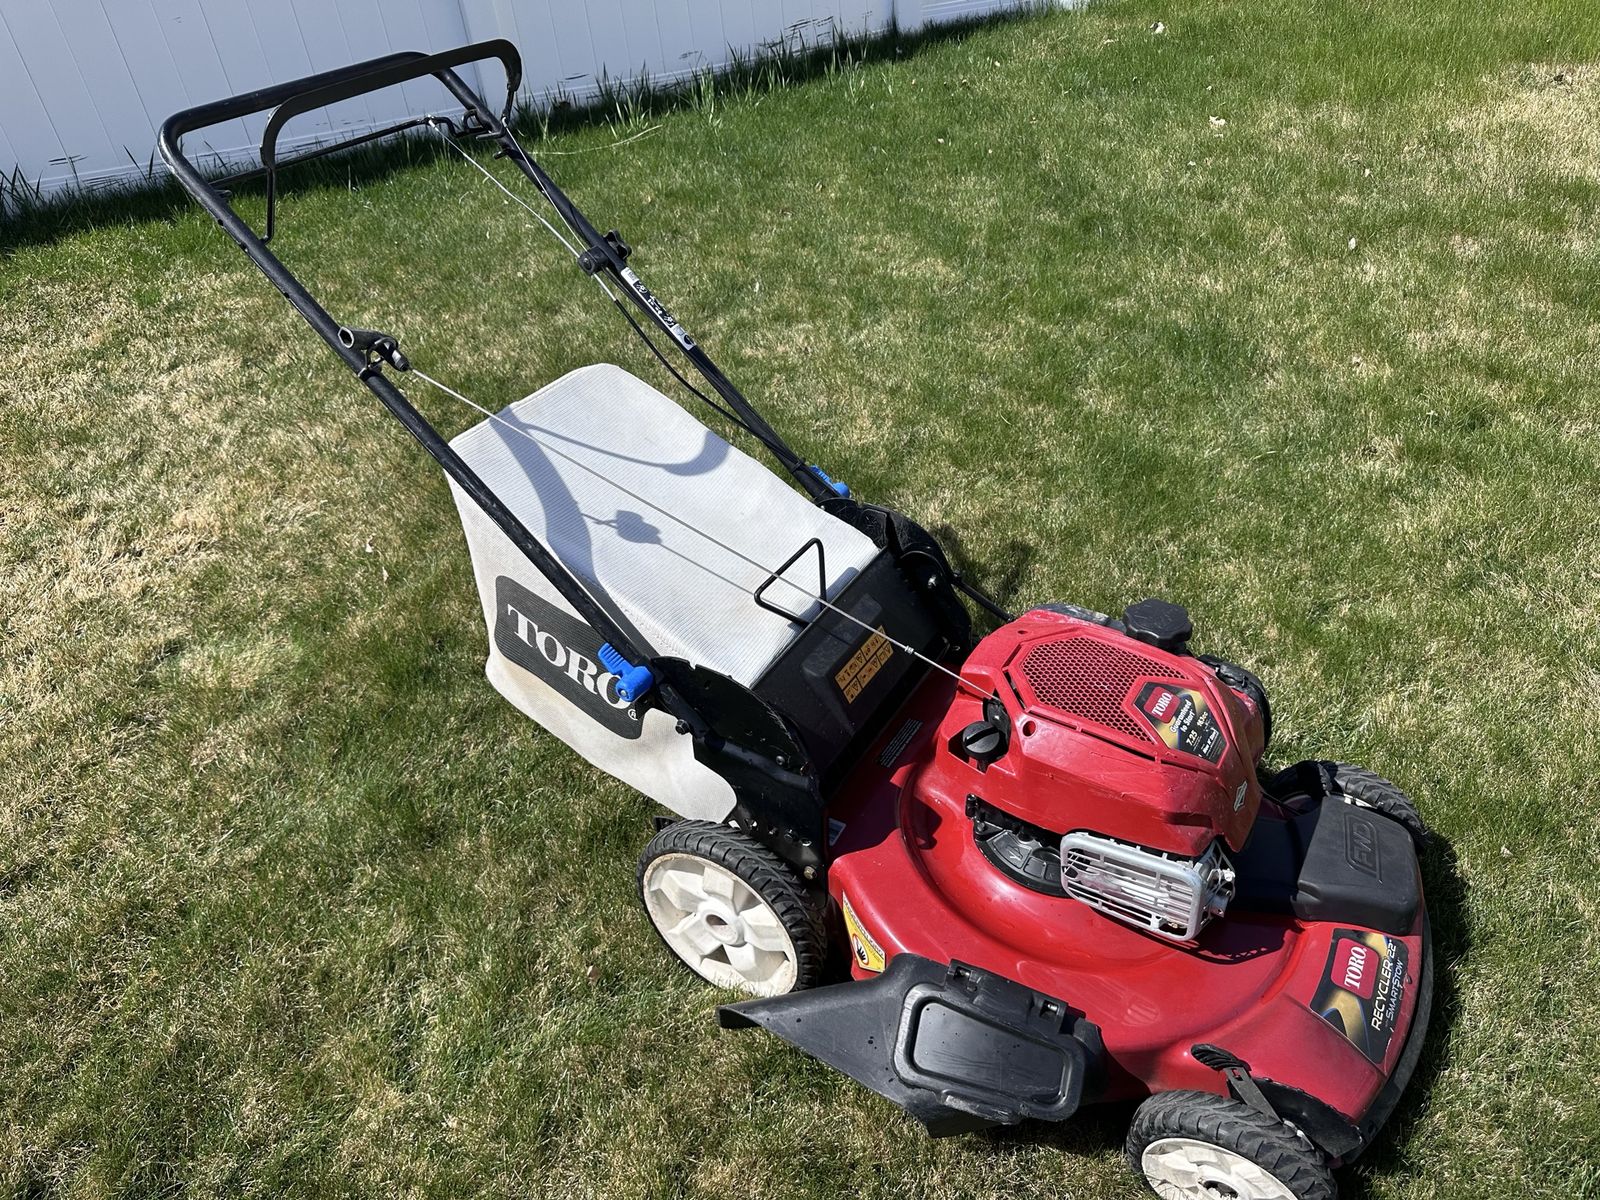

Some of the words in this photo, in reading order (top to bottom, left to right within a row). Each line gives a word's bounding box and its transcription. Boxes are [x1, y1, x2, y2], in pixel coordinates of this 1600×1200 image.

[507, 603, 632, 710] TORO
[1151, 692, 1173, 717] TORO
[1170, 699, 1193, 733] Guaranteed
[1180, 722, 1189, 733] to
[1185, 730, 1198, 746] 7.25
[1344, 946, 1367, 990] TORO
[1371, 959, 1393, 1031] RECYCLER
